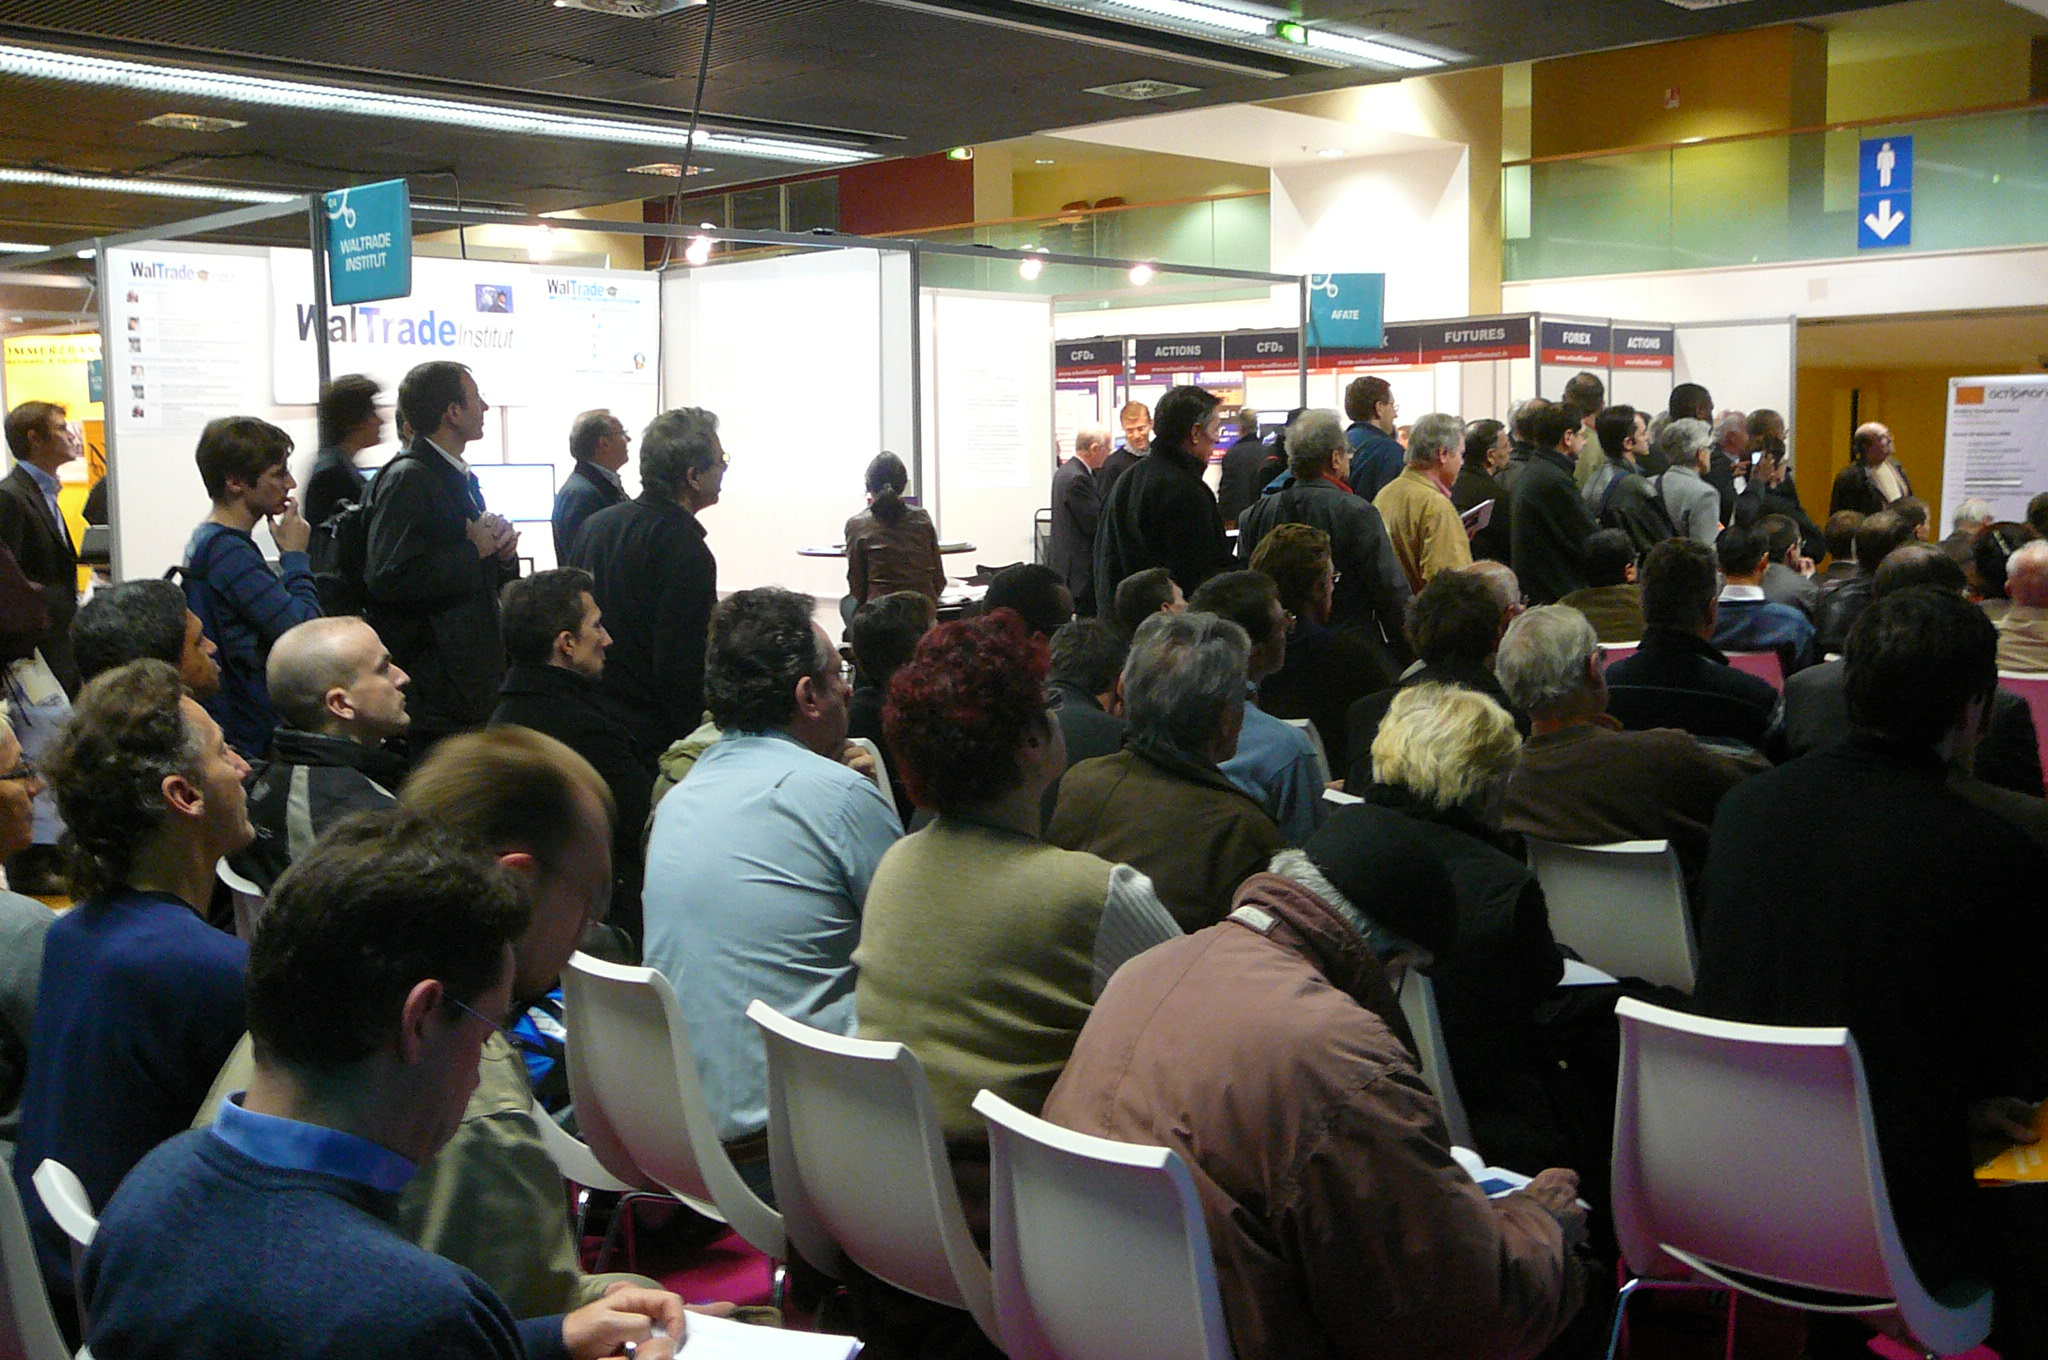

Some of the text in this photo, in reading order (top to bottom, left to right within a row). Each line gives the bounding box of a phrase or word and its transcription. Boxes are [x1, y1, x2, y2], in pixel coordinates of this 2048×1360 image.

[340, 232, 391, 254] WALTRADE
[346, 252, 387, 272] INSTITUT
[130, 261, 194, 281] WalTrade
[547, 278, 604, 297] WalTrade
[1331, 309, 1360, 320] AFATE
[1444, 327, 1506, 343] FUTURES
[1562, 331, 1591, 346] FOREX
[1154, 344, 1202, 357] ACTIONS
[1256, 341, 1284, 353] CFDs
[1627, 336, 1660, 350] ACTIONS
[1070, 350, 1095, 361] CFDs
